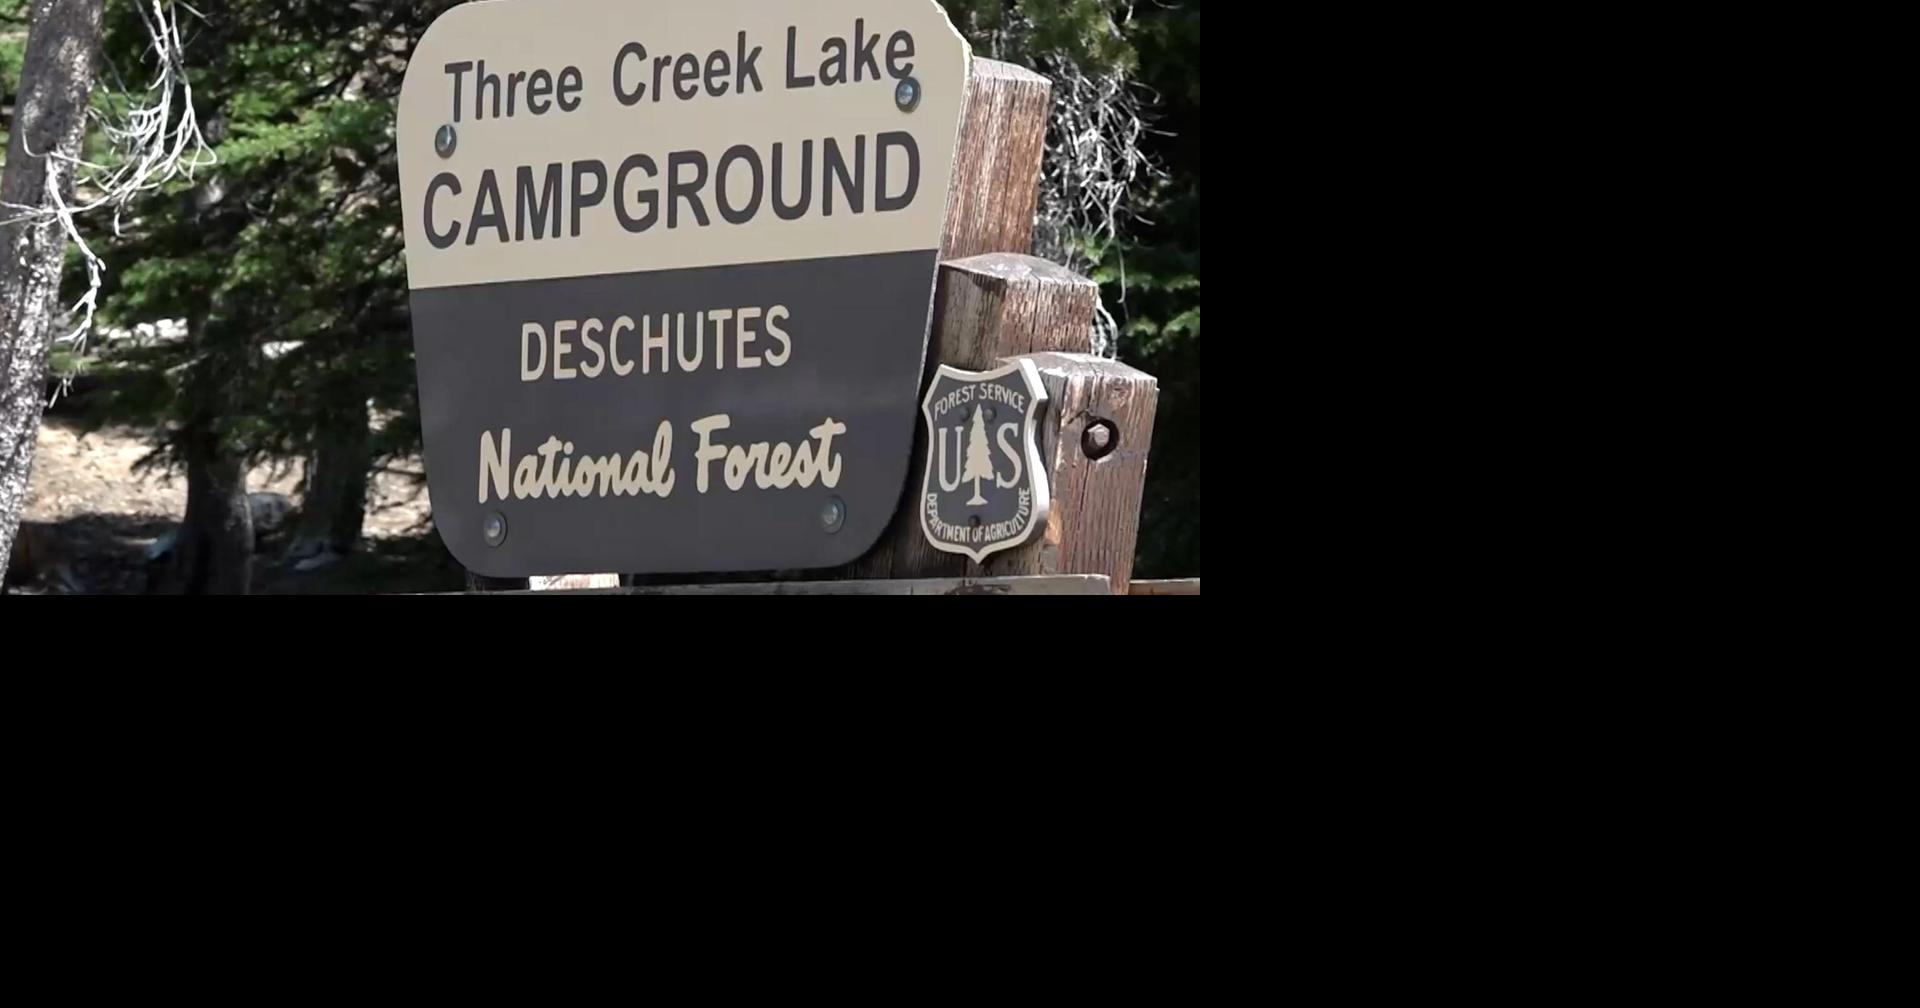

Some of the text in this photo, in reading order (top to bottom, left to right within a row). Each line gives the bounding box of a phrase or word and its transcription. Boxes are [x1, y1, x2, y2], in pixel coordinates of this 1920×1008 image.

[444, 18, 916, 123] Three Creek Lake
[423, 130, 921, 250] CAMPGROUND
[520, 305, 792, 382] DESCHUTES
[934, 382, 1025, 420] FOREST SERVICE
[478, 413, 847, 504] National Forest
[926, 487, 1031, 543] DEPARTMENT OF AGRICULTURE
